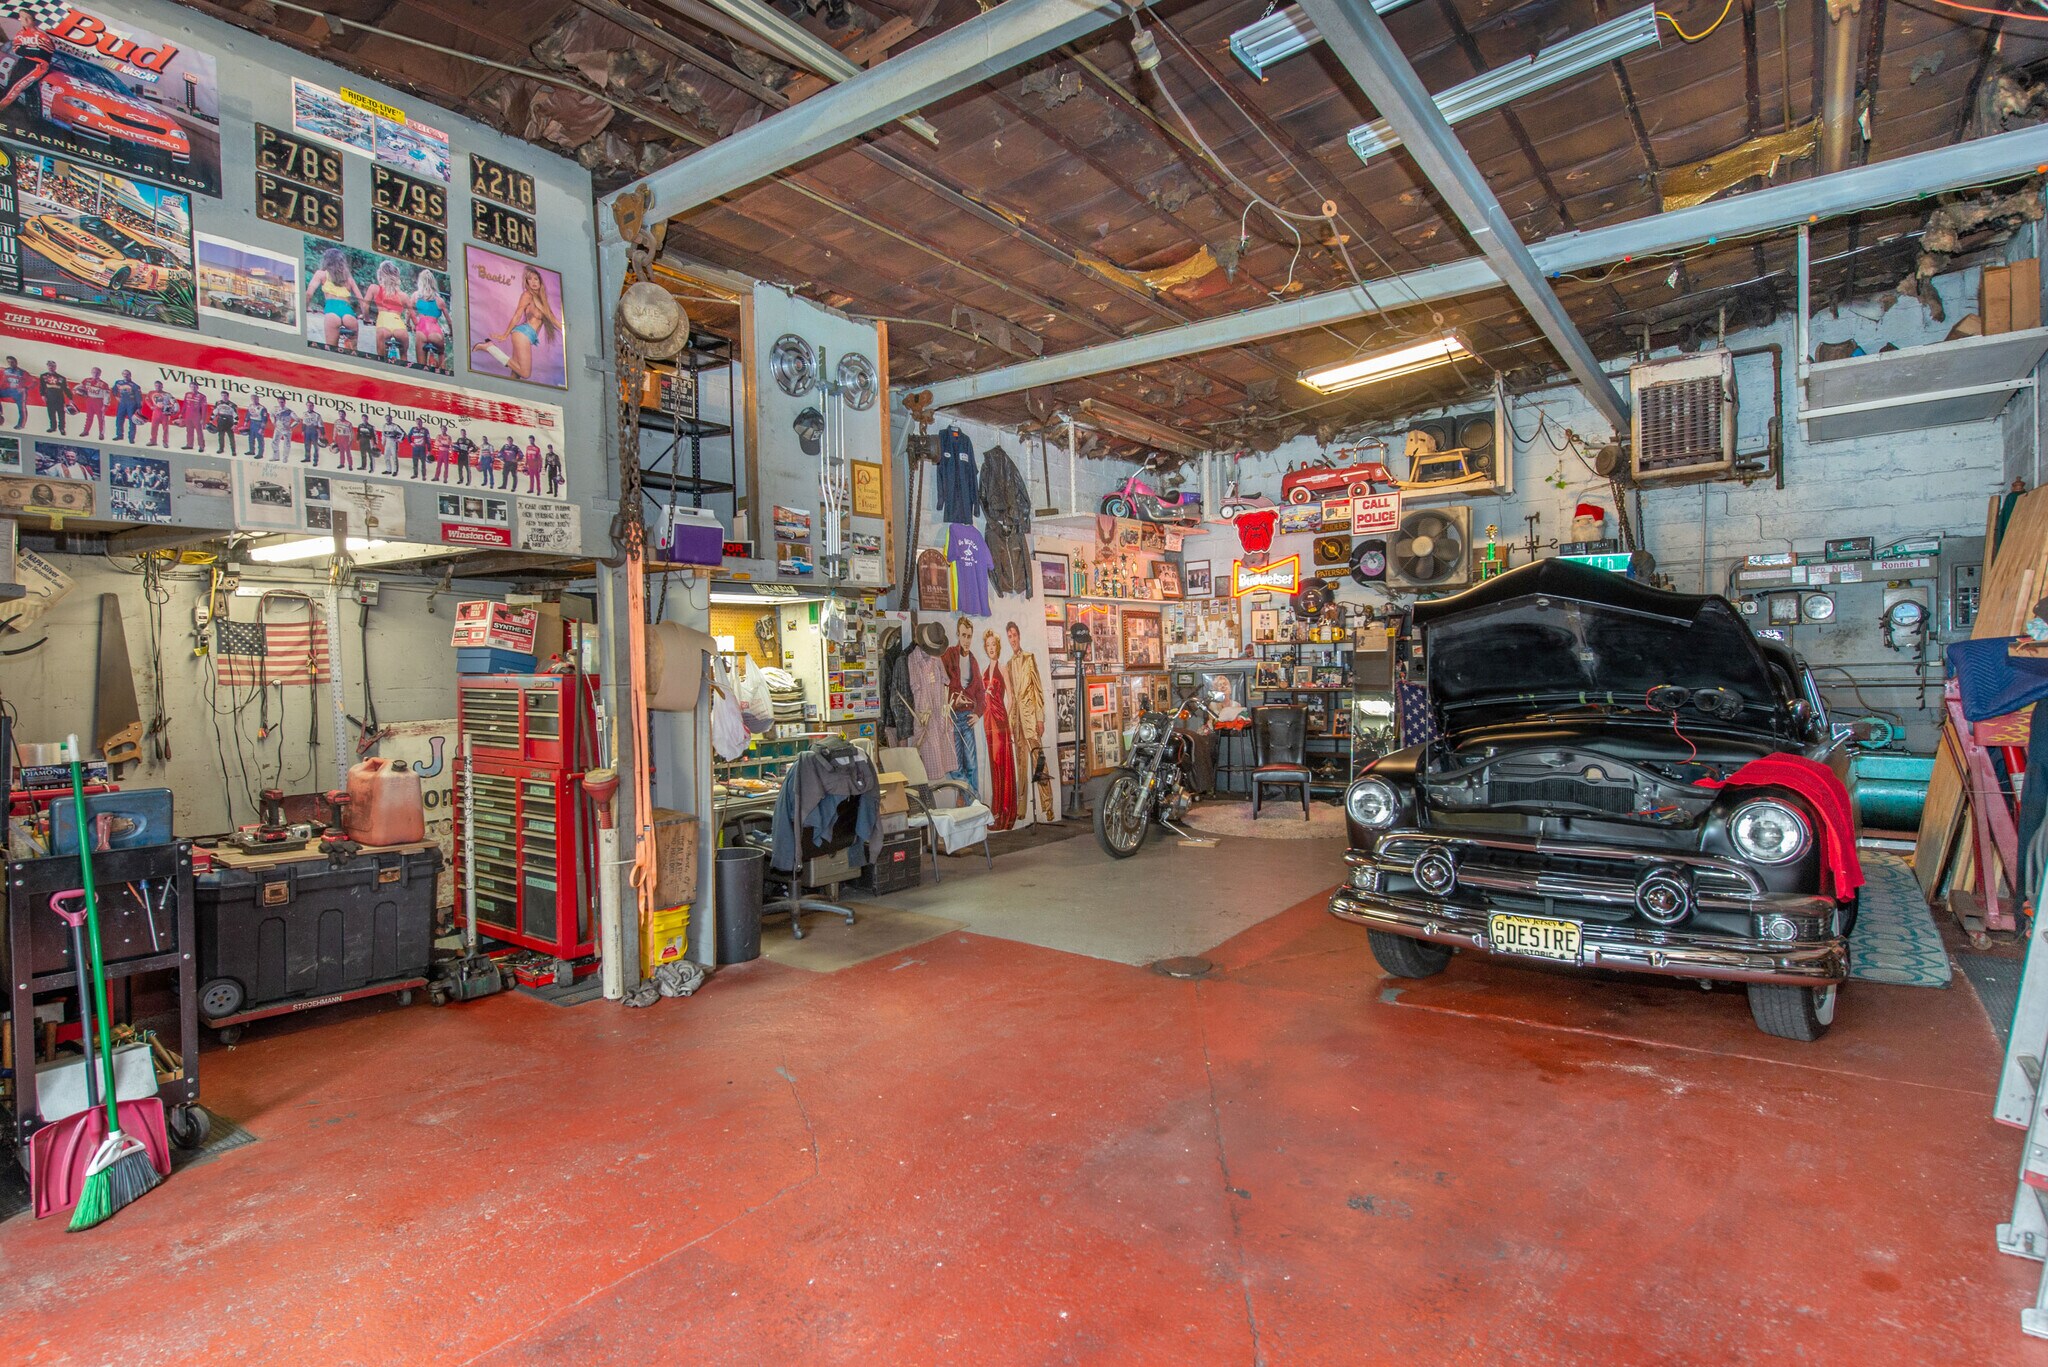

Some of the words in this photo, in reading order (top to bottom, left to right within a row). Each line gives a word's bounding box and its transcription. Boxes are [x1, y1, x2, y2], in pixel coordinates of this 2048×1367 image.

[47, 7, 179, 74] Bud
[119, 64, 159, 82] NASCAR
[16, 128, 128, 167] EARNHARDT,
[134, 163, 154, 174] JR
[170, 173, 205, 189] 1999
[281, 140, 338, 182] 78S
[393, 177, 443, 216] 79S
[489, 167, 532, 205] 218
[282, 187, 338, 228] 78S
[53, 221, 115, 255] PENNZOIL
[394, 222, 443, 259] 79S
[4, 313, 31, 324] THE
[34, 316, 98, 337] WINSTON
[159, 367, 217, 389] When
[221, 379, 250, 395] the
[254, 386, 303, 403] green
[307, 393, 356, 413] drops,
[360, 403, 384, 417] the
[389, 406, 416, 422] bull
[420, 412, 458, 430] stops.
[1362, 498, 1390, 510] CALL
[1357, 511, 1396, 524] POLICE
[448, 530, 484, 540] Winston
[485, 533, 503, 543] Cup
[26, 553, 43, 568] NAPA
[42, 563, 60, 579] Silver
[1316, 568, 1350, 577] PATERSON
[1586, 557, 1614, 569] 4th
[1881, 560, 1913, 569] Ronnie
[1238, 573, 1294, 587] Budweiser
[493, 622, 532, 635] SYNTHETIC
[413, 736, 446, 778] J
[26, 768, 65, 776] DIAMOND
[1532, 918, 1557, 927] Jersey
[1507, 924, 1576, 952] DESIRE
[1516, 948, 1554, 958] HISTORIC
[292, 996, 342, 1011] STROEHMANN
